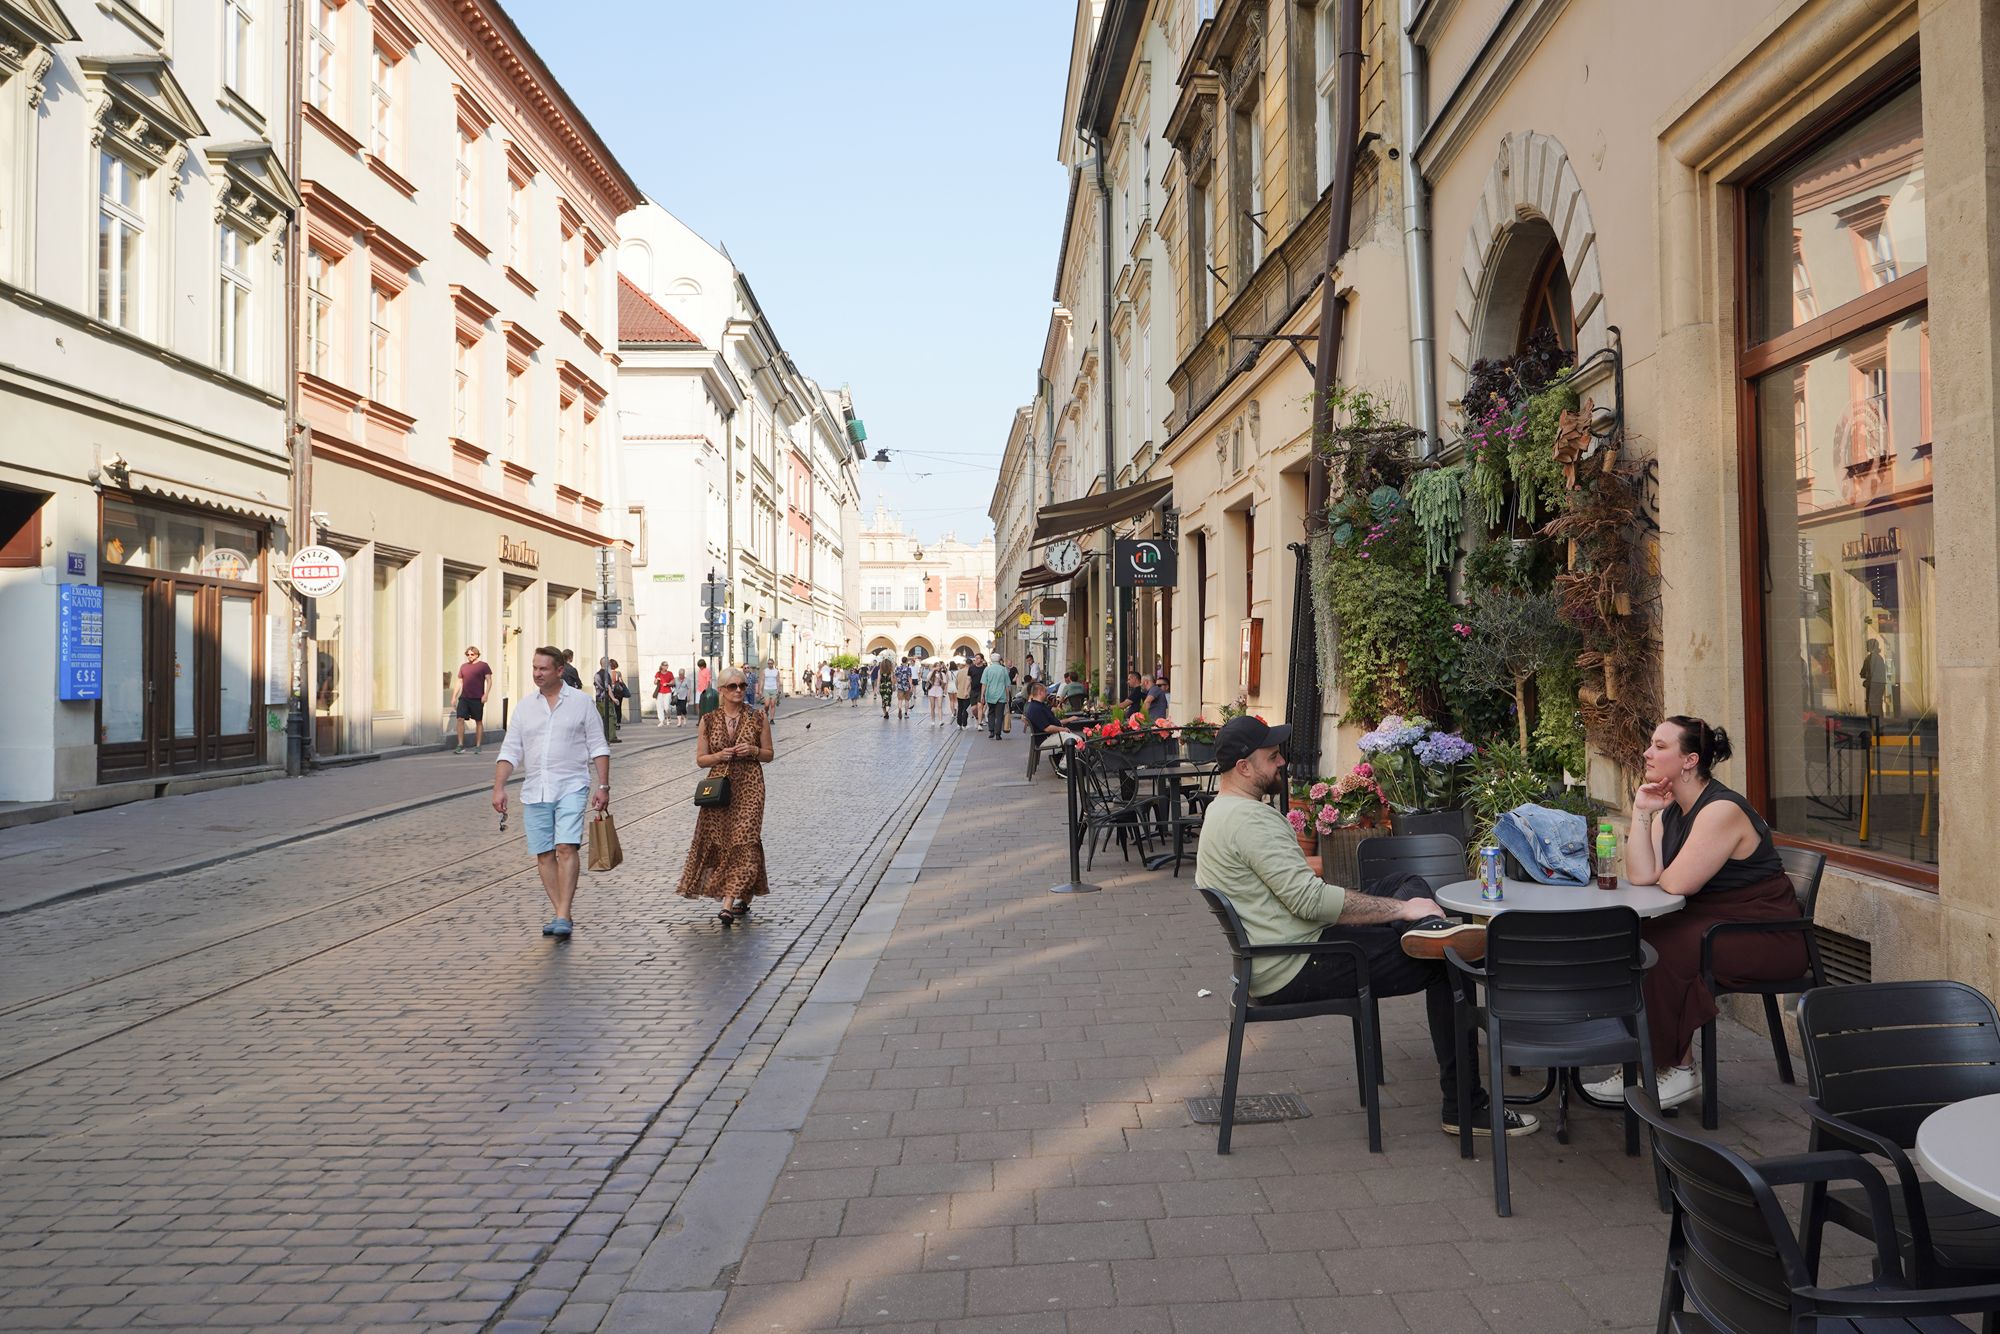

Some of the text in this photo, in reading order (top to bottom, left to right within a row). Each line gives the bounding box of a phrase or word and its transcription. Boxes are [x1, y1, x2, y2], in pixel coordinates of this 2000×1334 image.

[299, 551, 330, 562] PIZZA
[74, 558, 83, 569] 15
[294, 567, 337, 578] KEBAB
[72, 588, 102, 598] EXCHANGE
[71, 596, 102, 609] KANTOR
[84, 669, 90, 682] $
